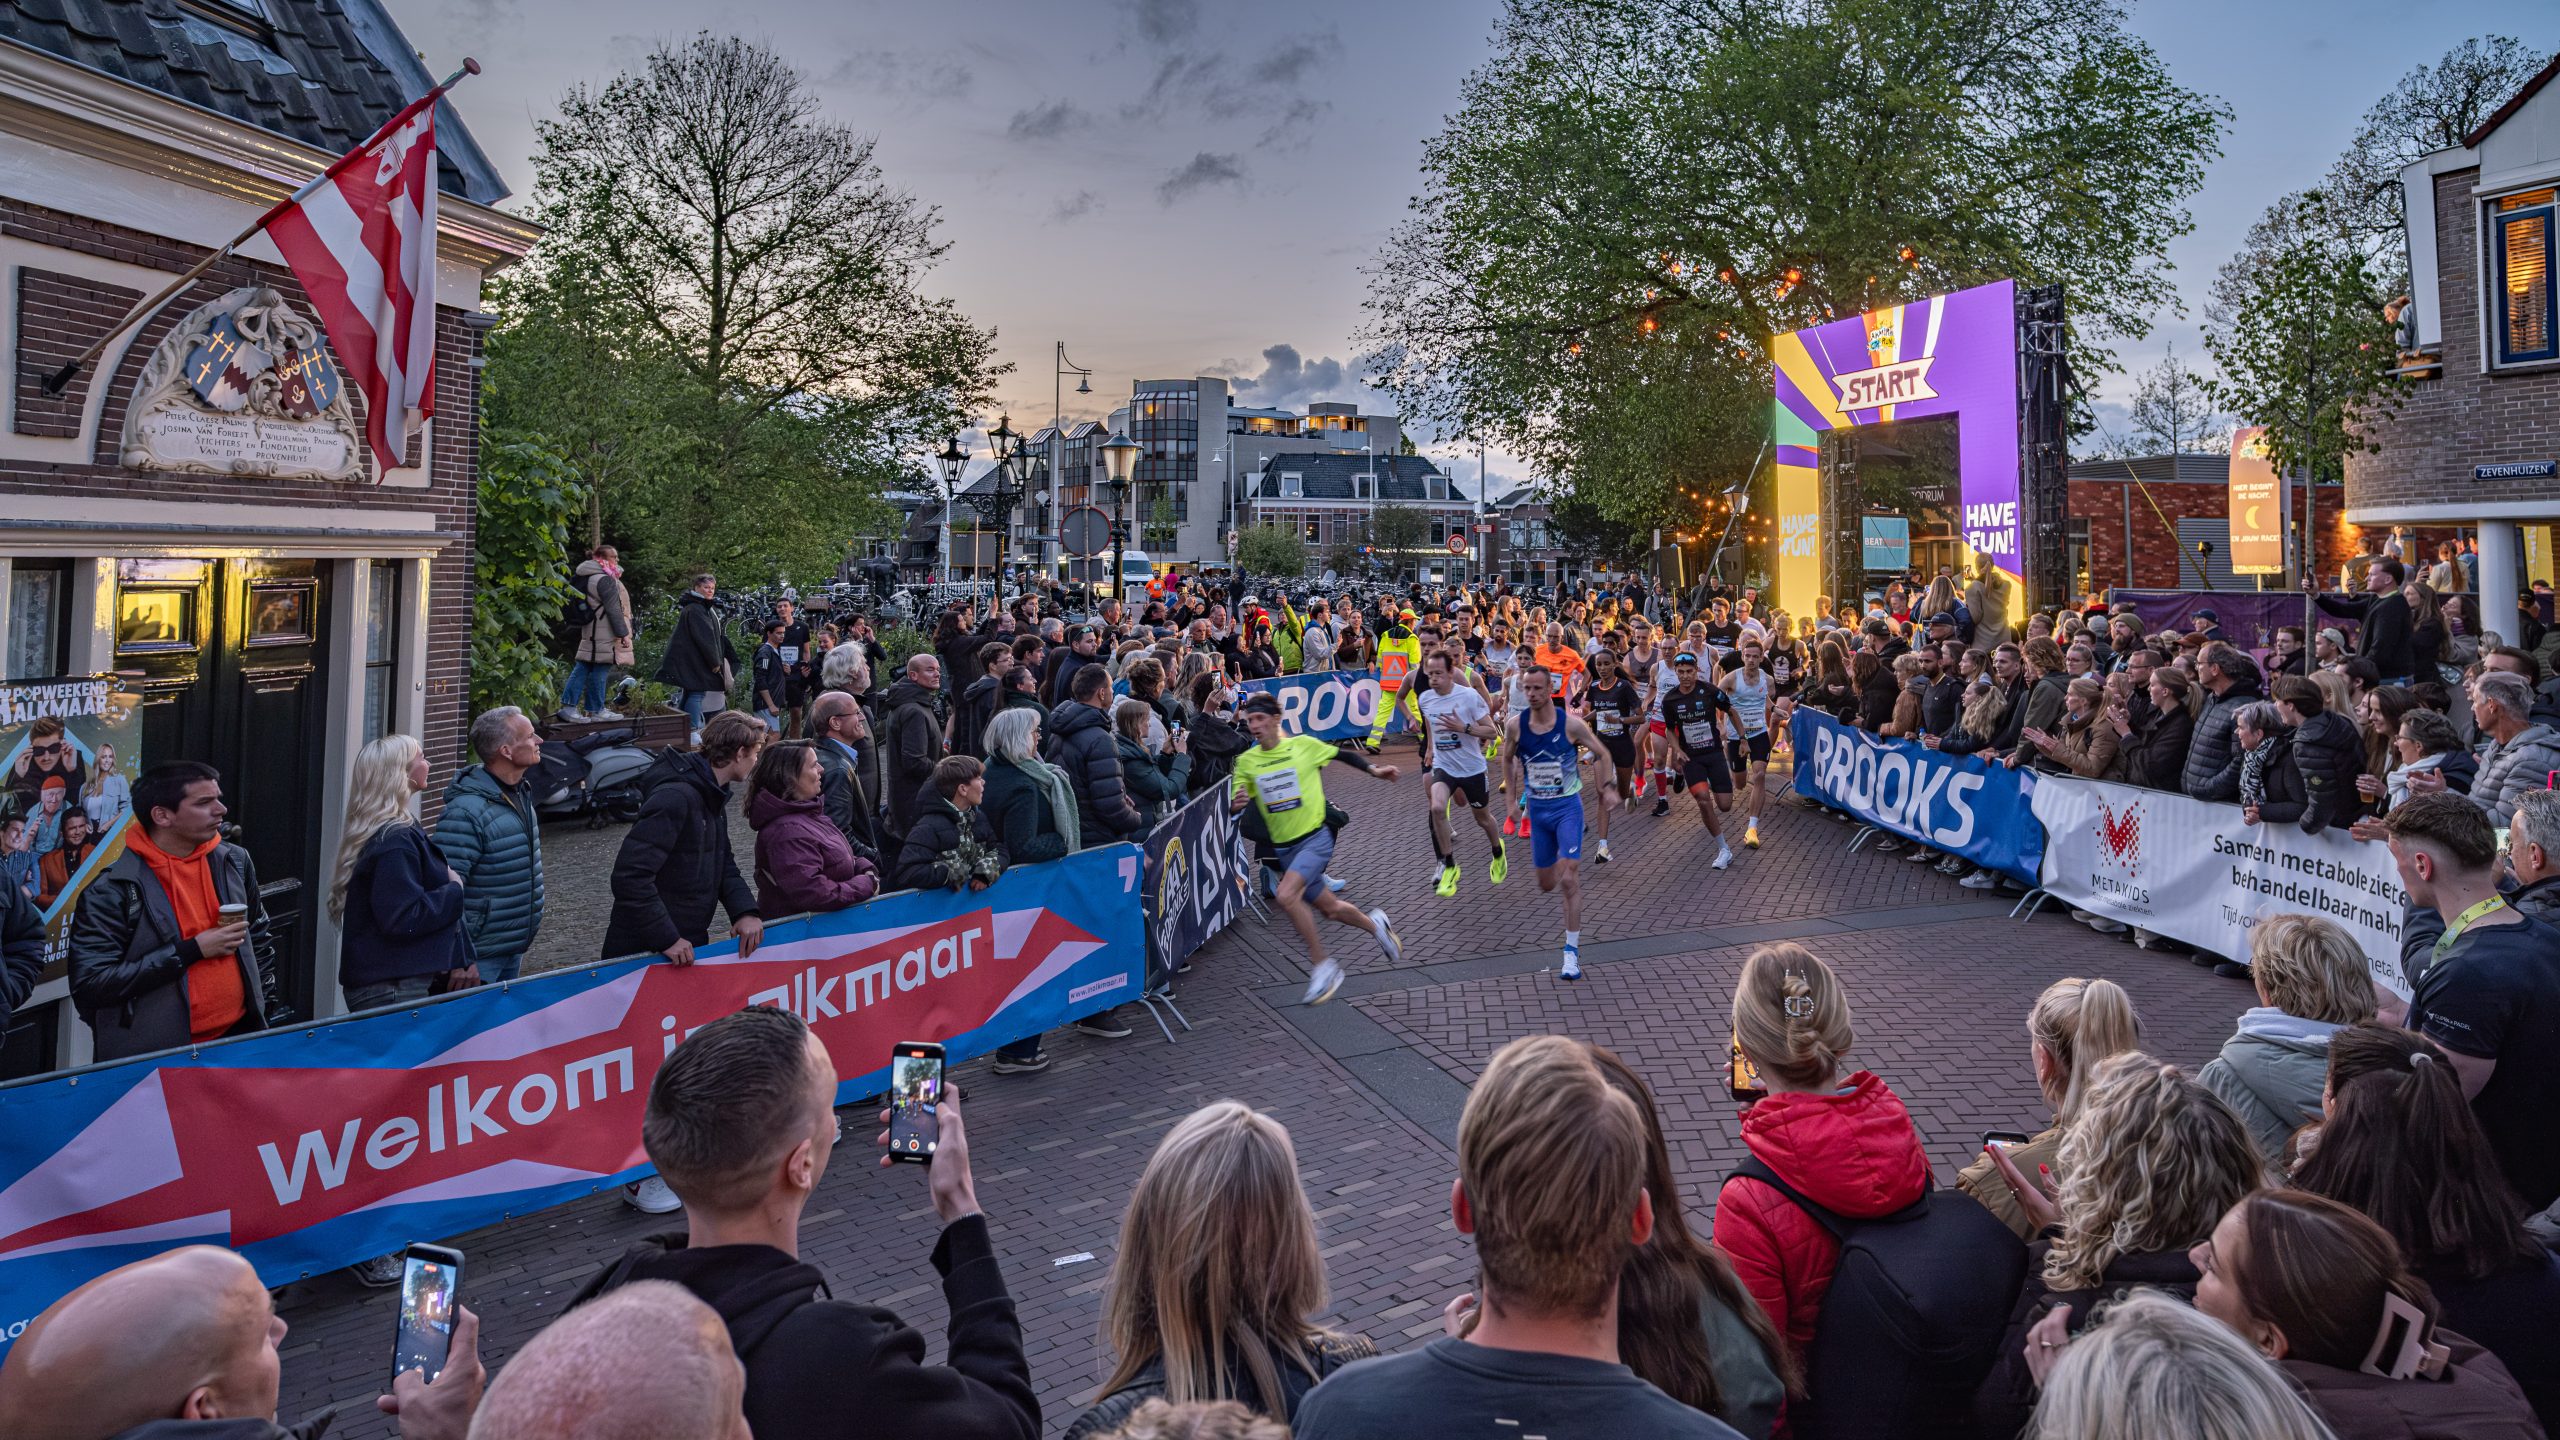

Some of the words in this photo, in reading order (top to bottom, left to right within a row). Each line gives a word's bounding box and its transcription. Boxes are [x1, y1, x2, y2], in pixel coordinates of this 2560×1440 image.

[1848, 367, 1920, 404] START
[2480, 465, 2549, 478] ZEVENHUIZEN
[1781, 514, 1819, 535] HAVE
[1966, 501, 2017, 528] HAVE
[1969, 527, 2015, 555] FUN!
[13, 681, 108, 703] POPWEEKEND
[1813, 726, 1985, 848] BROOKS
[2213, 834, 2275, 864] Samen
[2281, 851, 2368, 891] metabole
[2092, 873, 2150, 904] METAKIDS
[2232, 865, 2358, 921] behandelbaar
[2222, 904, 2238, 927] Tijd
[258, 1046, 635, 1206] Welkom
